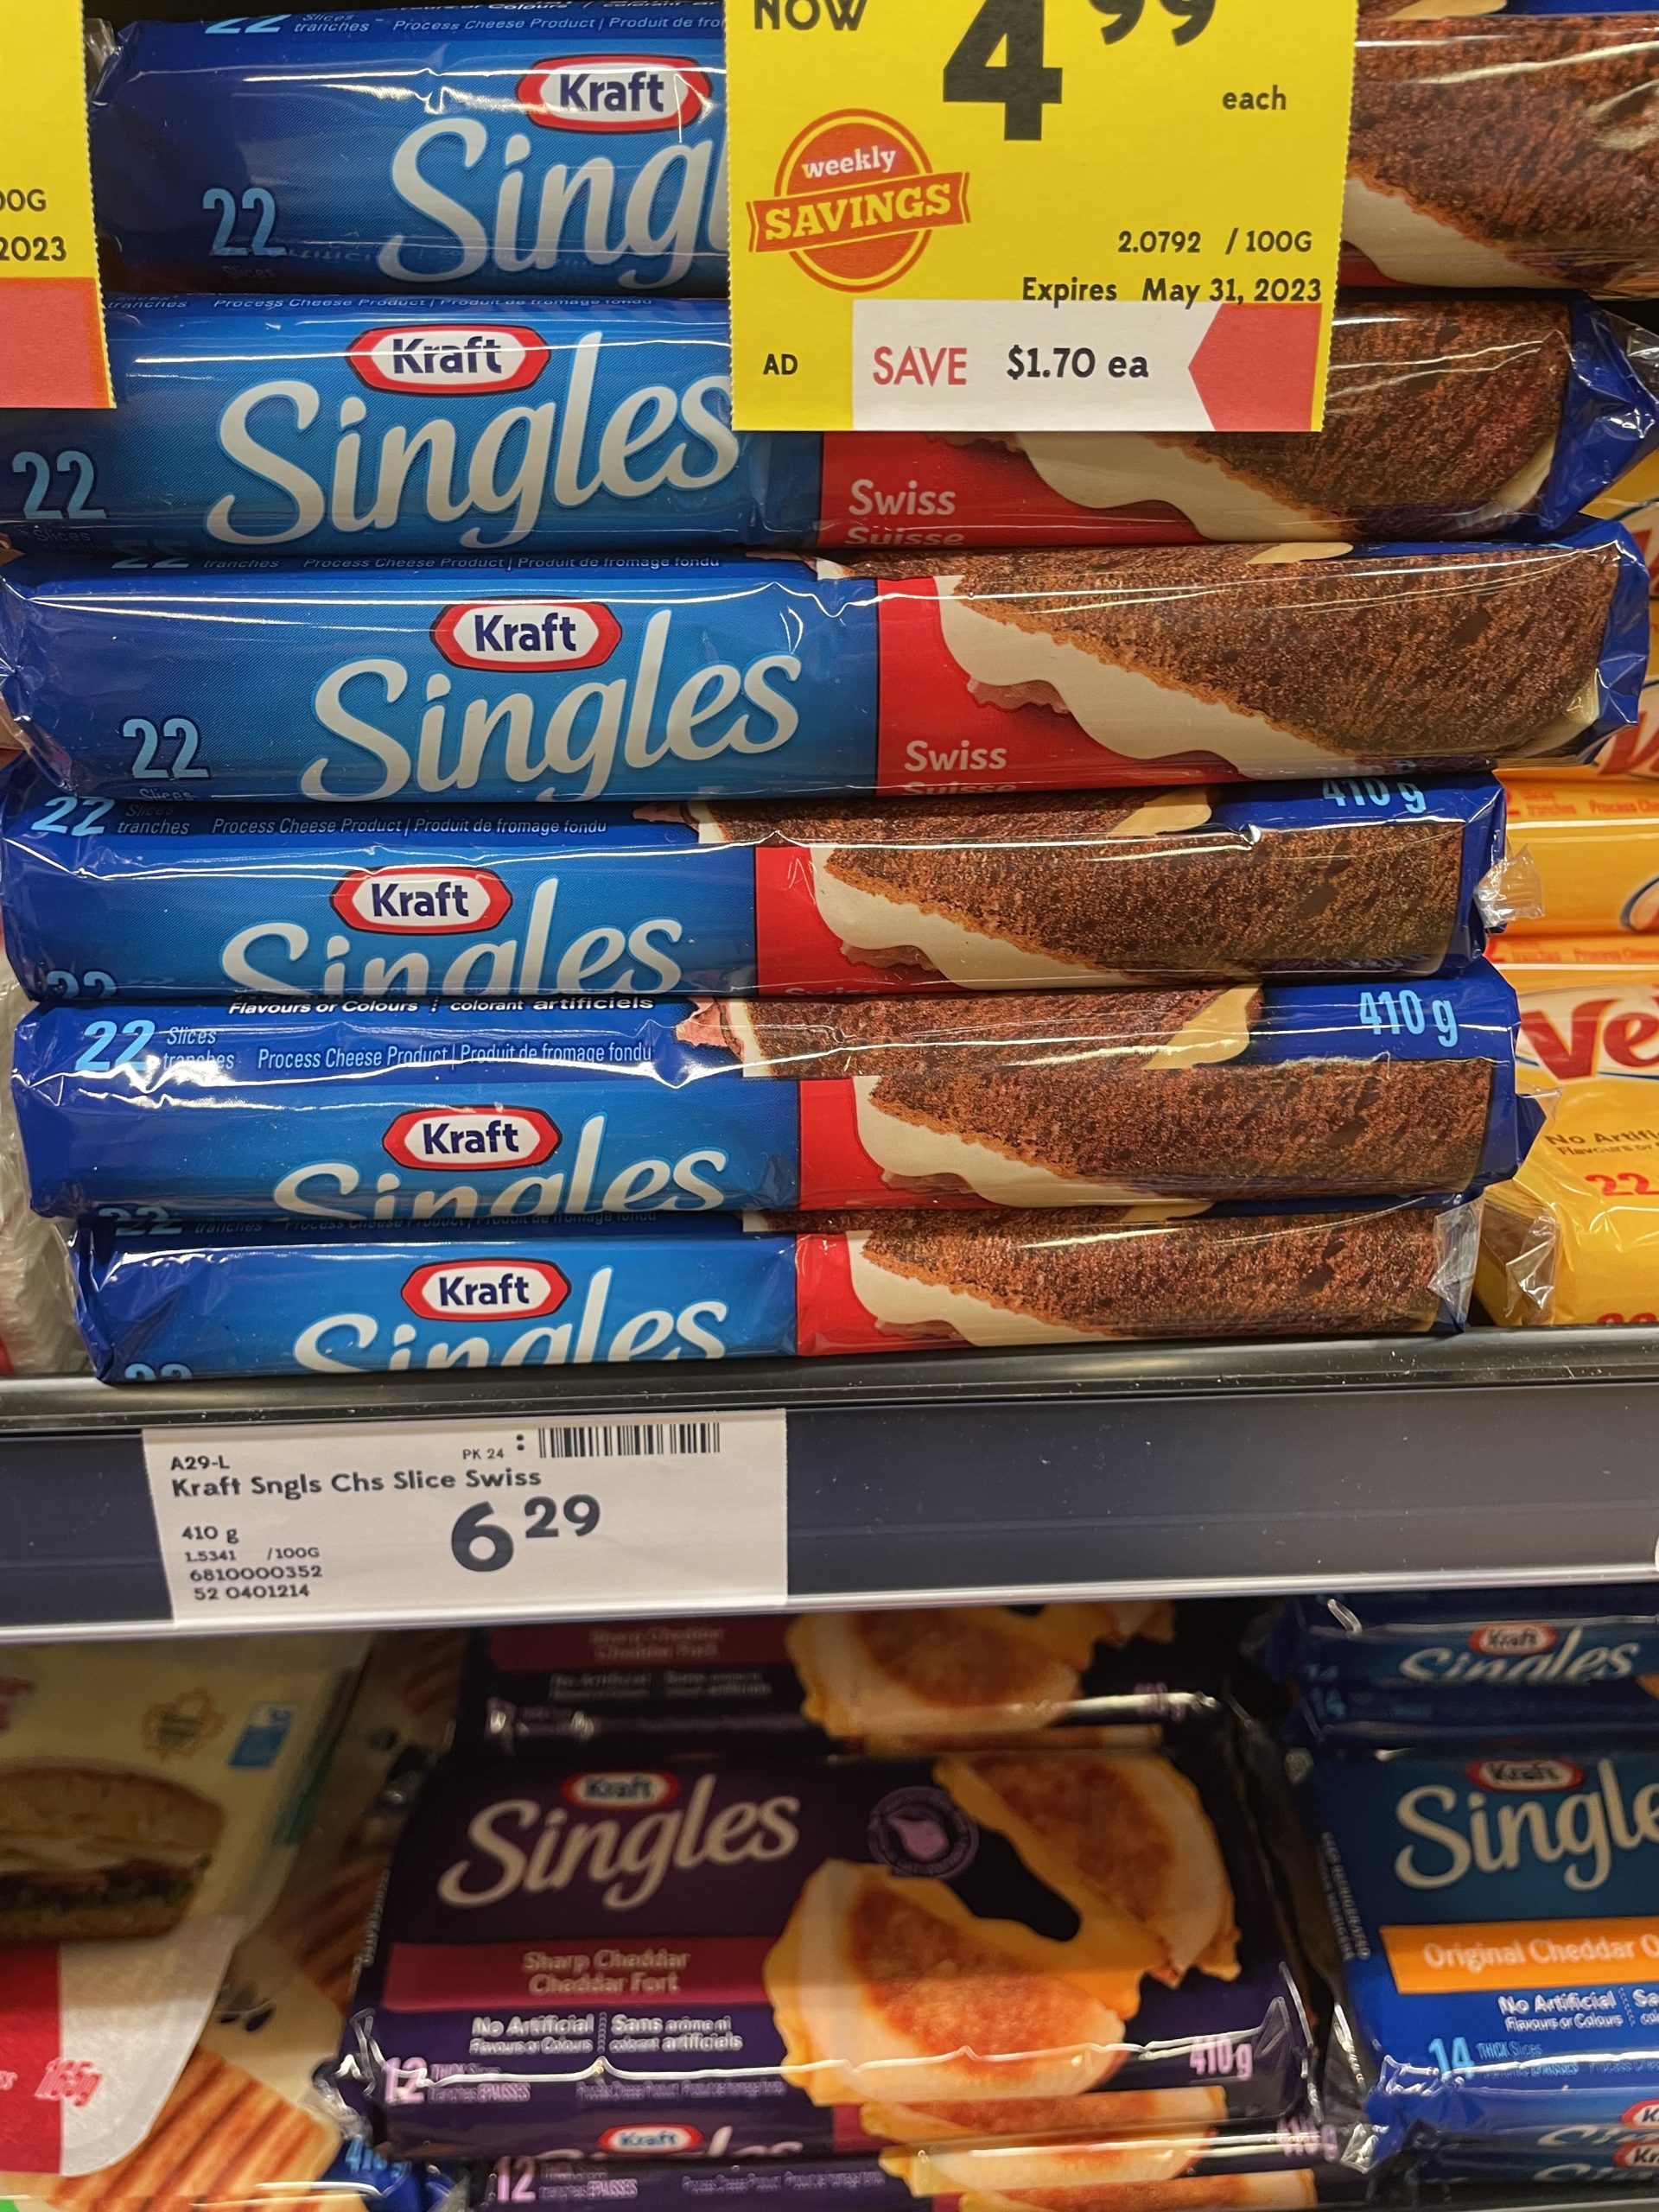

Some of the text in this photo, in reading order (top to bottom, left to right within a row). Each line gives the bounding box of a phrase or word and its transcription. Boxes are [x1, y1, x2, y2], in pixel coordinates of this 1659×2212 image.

[294, 16, 724, 33] tranches Process Cheese Product Produit de fro
[753, 0, 864, 32] NOW
[559, 72, 664, 114] Kraft
[1223, 86, 1287, 111] each
[802, 145, 897, 181] weekly
[0, 188, 48, 212] 0G
[378, 118, 726, 289] Sing
[765, 183, 951, 242] SAVINGS
[202, 188, 286, 257] 22
[0, 236, 67, 262] 2023
[1118, 231, 1201, 254] 2.0792
[213, 299, 283, 308] Process
[289, 298, 353, 308] Cheese
[358, 297, 424, 308] Product
[439, 298, 501, 307] Produit
[505, 298, 528, 307] de
[1022, 276, 1323, 309] Expires May 31, 2023
[393, 336, 502, 375] Kraft
[763, 353, 798, 377] AD
[873, 346, 1149, 387] SAVE $1.70 ea
[206, 331, 740, 550] Singles
[12, 450, 108, 519] 22
[849, 478, 957, 517] Swiss
[844, 526, 966, 546] Suisse
[304, 558, 370, 569] Process
[375, 557, 435, 569] Cheese
[440, 556, 505, 569] Product
[518, 556, 575, 569] Produit
[580, 556, 600, 568] de
[603, 556, 670, 570] fromage
[675, 556, 721, 568] fondu
[475, 611, 576, 652] Kraft
[300, 608, 803, 803] Singles
[123, 717, 210, 779] 22
[904, 740, 1007, 772] Swiss
[1322, 778, 1427, 814] 410 g
[30, 796, 116, 836] 22
[118, 817, 607, 836] tranches Process Cheese Product Produit de fromage fondu
[372, 882, 470, 918] Kraft
[229, 995, 654, 1015] Flavours or Colours colorant artificiels
[1359, 990, 1458, 1047] 410 g
[75, 1020, 216, 1072] 22 Slices
[259, 1047, 321, 1070] Process
[326, 1046, 383, 1067] Cheese
[387, 1044, 448, 1065] Product
[461, 1042, 515, 1062] Produit
[519, 1043, 538, 1062] de
[543, 1042, 604, 1063] fromage
[609, 1041, 652, 1062] fondu
[1519, 998, 1659, 1080] Ve
[423, 1118, 519, 1154] Kraft
[1545, 1129, 1659, 1145] No Artifi
[1557, 1143, 1632, 1156] Flavours
[438, 1274, 531, 1307] Kraft
[171, 1447, 505, 1471] A29-L PK 24
[172, 1467, 542, 1501] Kraft Sngls Chs Slice Swiss
[182, 1526, 239, 1544] 410 g
[190, 1565, 323, 1581] 6810000352
[194, 1584, 310, 1600] 52 0401214
[585, 1774, 653, 1801] Kraft
[437, 1772, 801, 1911] Singles
[1394, 1758, 1659, 1892] Single
[1423, 1933, 1659, 1974] Original Cheddar O
[1497, 1988, 1659, 2016] No Artificial Sa
[472, 2017, 505, 2037] No
[611, 2013, 664, 2036] Sans
[1573, 2012, 1624, 2030] Colours
[1428, 2037, 1475, 2081] 14
[385, 2057, 428, 2105] 12
[620, 2130, 677, 2150] Kraft
[1632, 2146, 1659, 2164] Kr
[496, 2155, 537, 2204] 12
